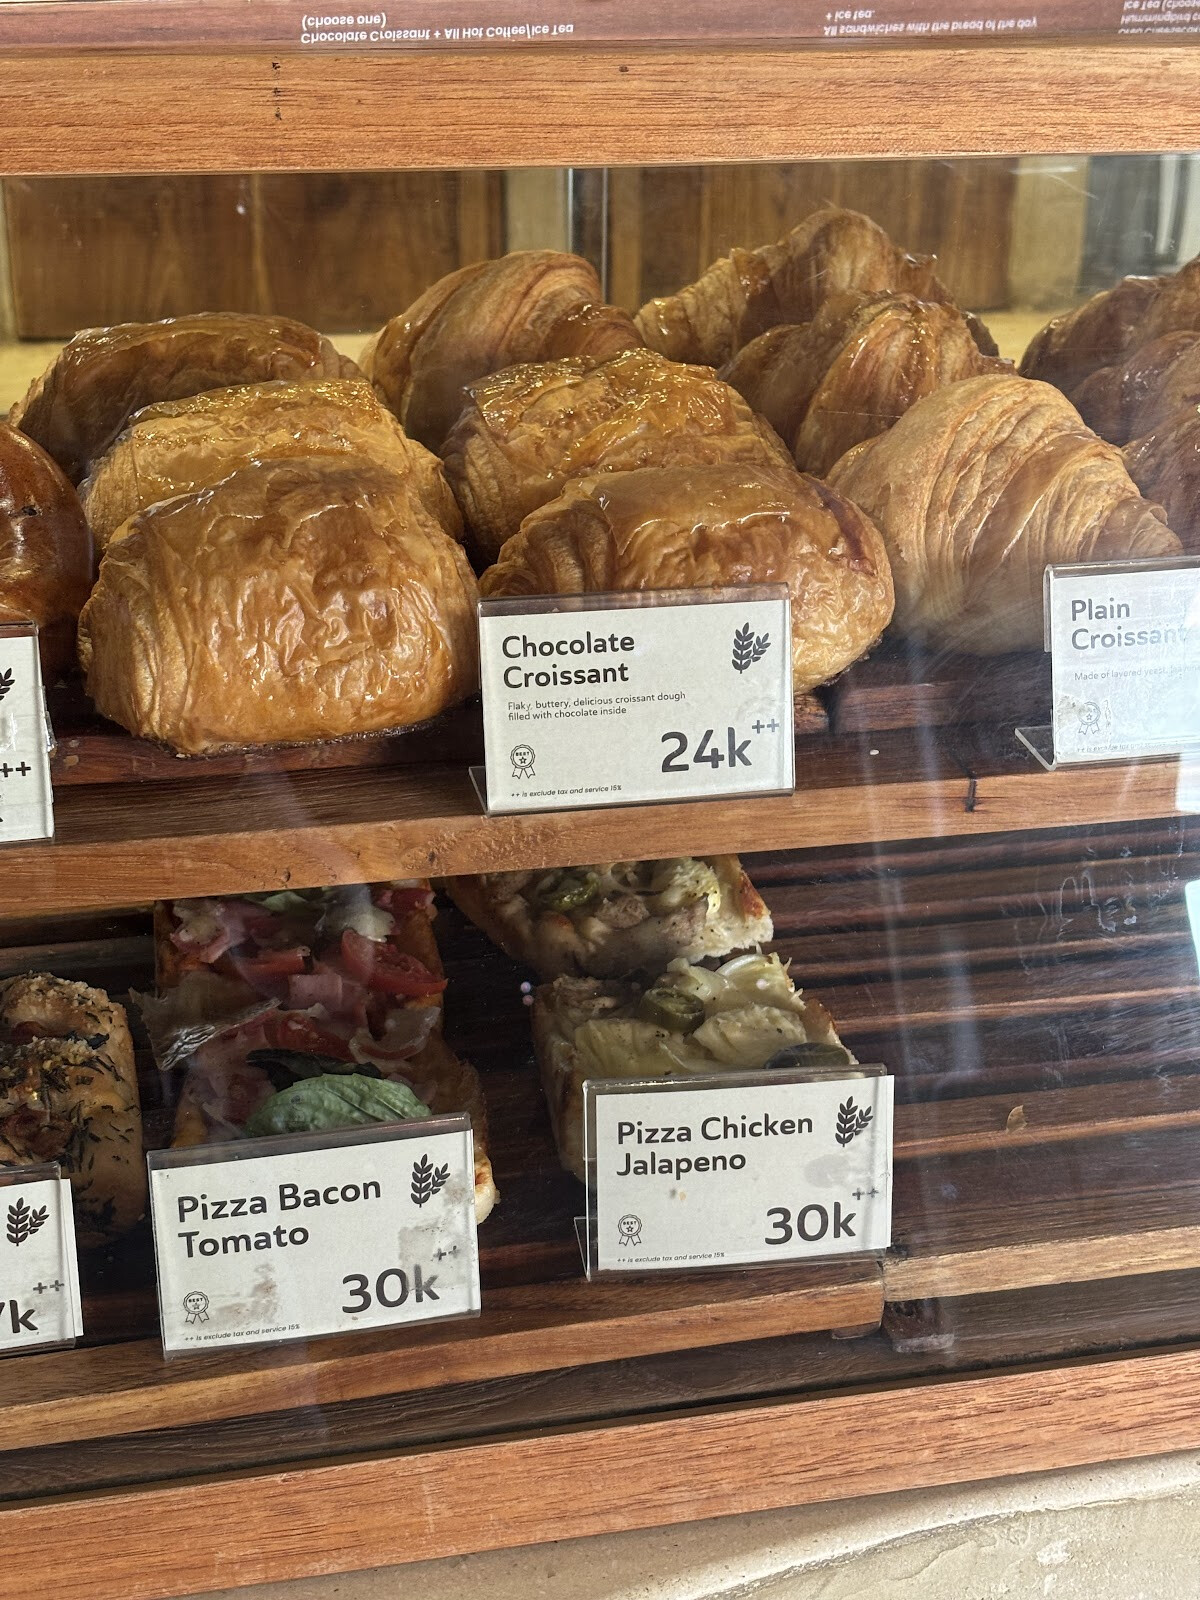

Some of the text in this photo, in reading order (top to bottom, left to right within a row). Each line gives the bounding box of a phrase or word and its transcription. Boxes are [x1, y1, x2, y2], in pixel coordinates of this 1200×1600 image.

[1072, 597, 1130, 622] Plain
[502, 631, 635, 658] Chocolate
[503, 663, 629, 688] Croissant
[1074, 672, 1098, 680] Made
[1101, 670, 1110, 678] of
[508, 691, 686, 711] Flaky, buttery, delicious croissant dough
[508, 706, 627, 721] filled with chocolate inside
[618, 1113, 813, 1145] Pizza Chicken
[616, 1152, 746, 1180] Jalapeno
[178, 1180, 381, 1223] Pizza Bacon
[178, 1225, 309, 1258] Tomato
[204, 1332, 231, 1340] exclude
[262, 1326, 287, 1334] service
